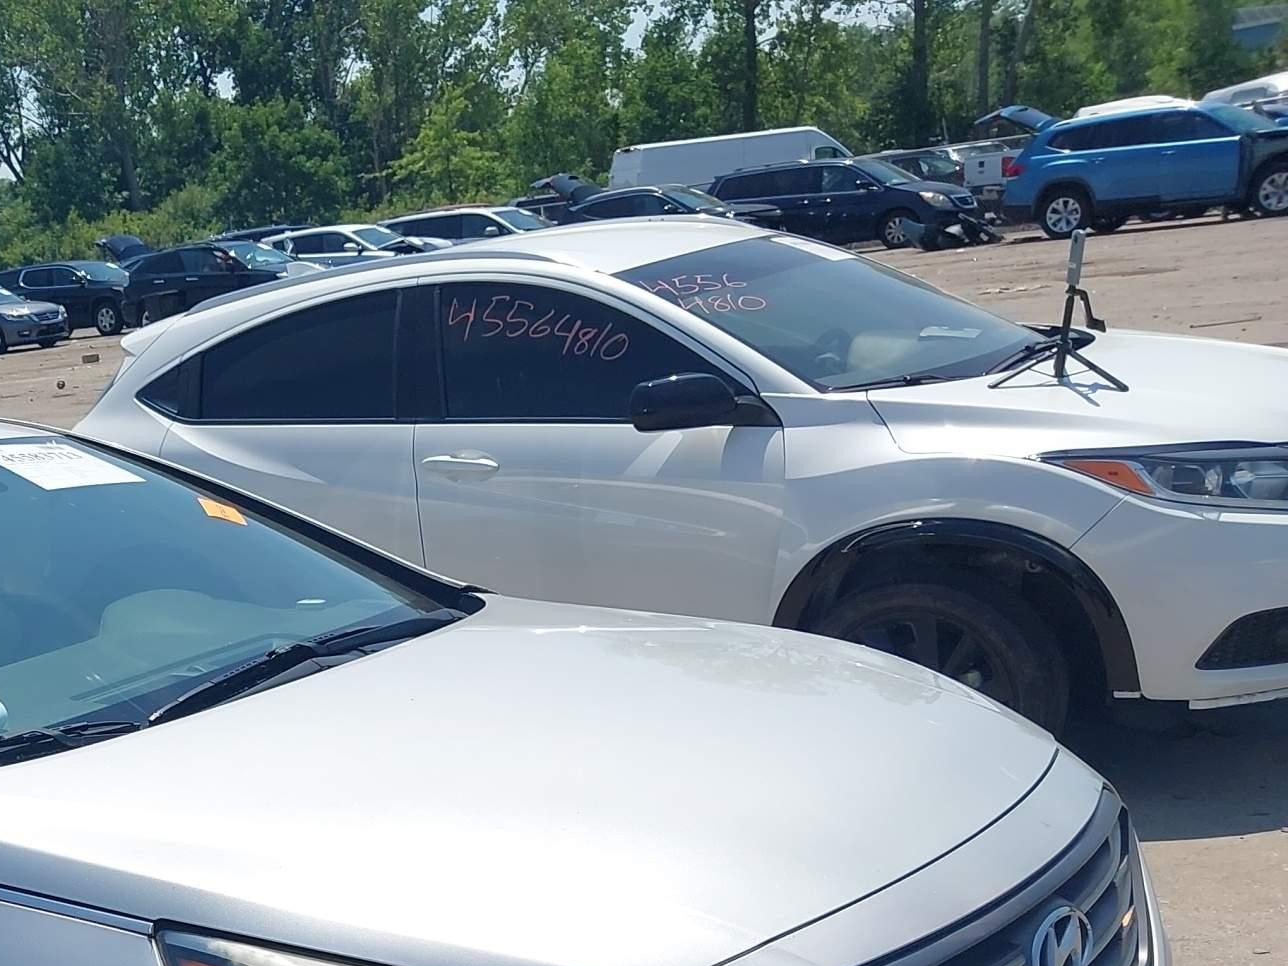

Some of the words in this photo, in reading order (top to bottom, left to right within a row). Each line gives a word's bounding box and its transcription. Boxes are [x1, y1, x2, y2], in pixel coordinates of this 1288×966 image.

[638, 273, 747, 296] 4556
[677, 294, 767, 314] 4810
[448, 295, 630, 361] 45564810
